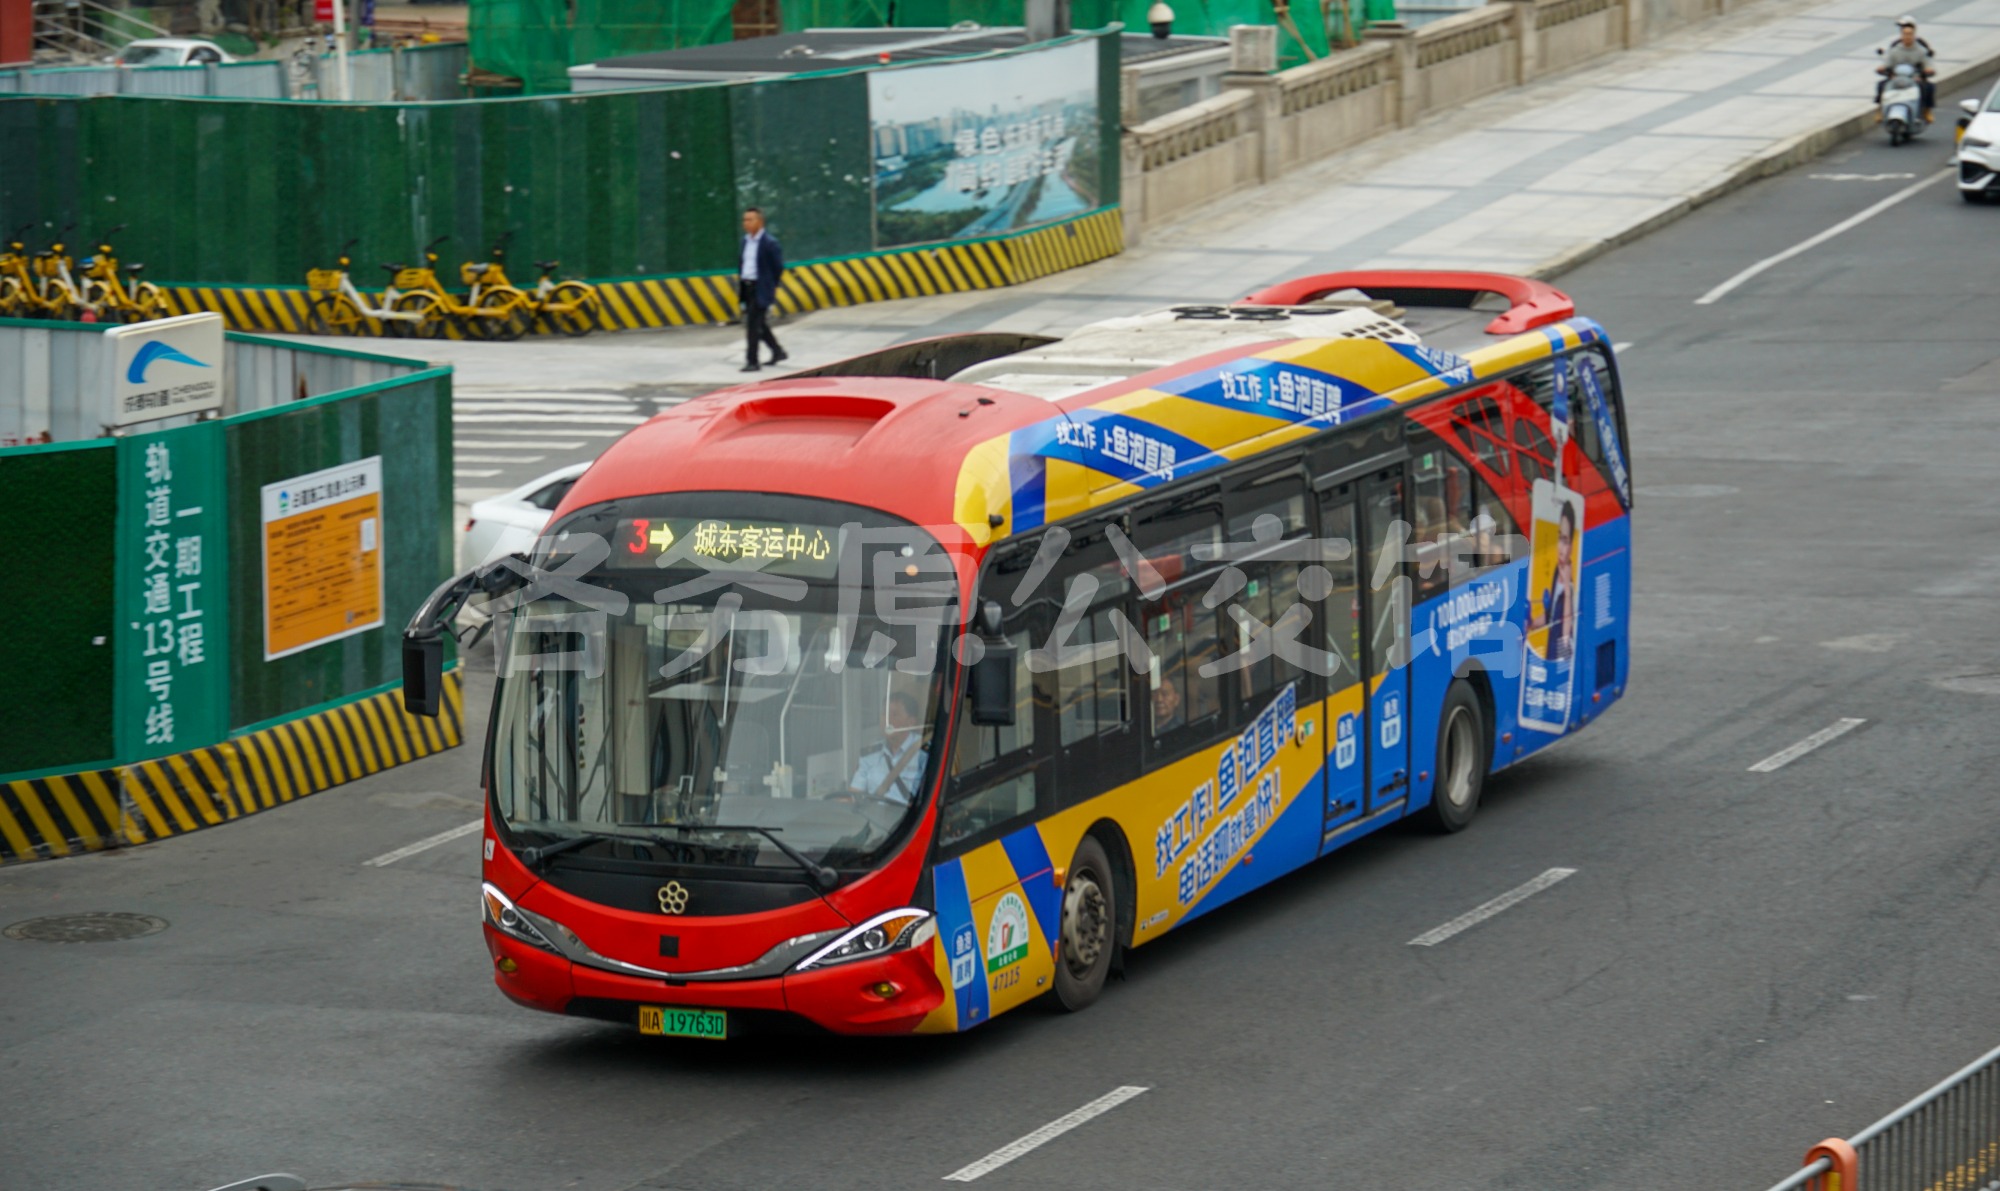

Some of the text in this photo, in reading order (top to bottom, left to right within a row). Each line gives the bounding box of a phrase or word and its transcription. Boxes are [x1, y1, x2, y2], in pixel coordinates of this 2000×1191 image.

[143, 441, 175, 745] 轨道交通13号线
[174, 506, 205, 667] 一期工程
[629, 519, 830, 560] 3 城东客运中心
